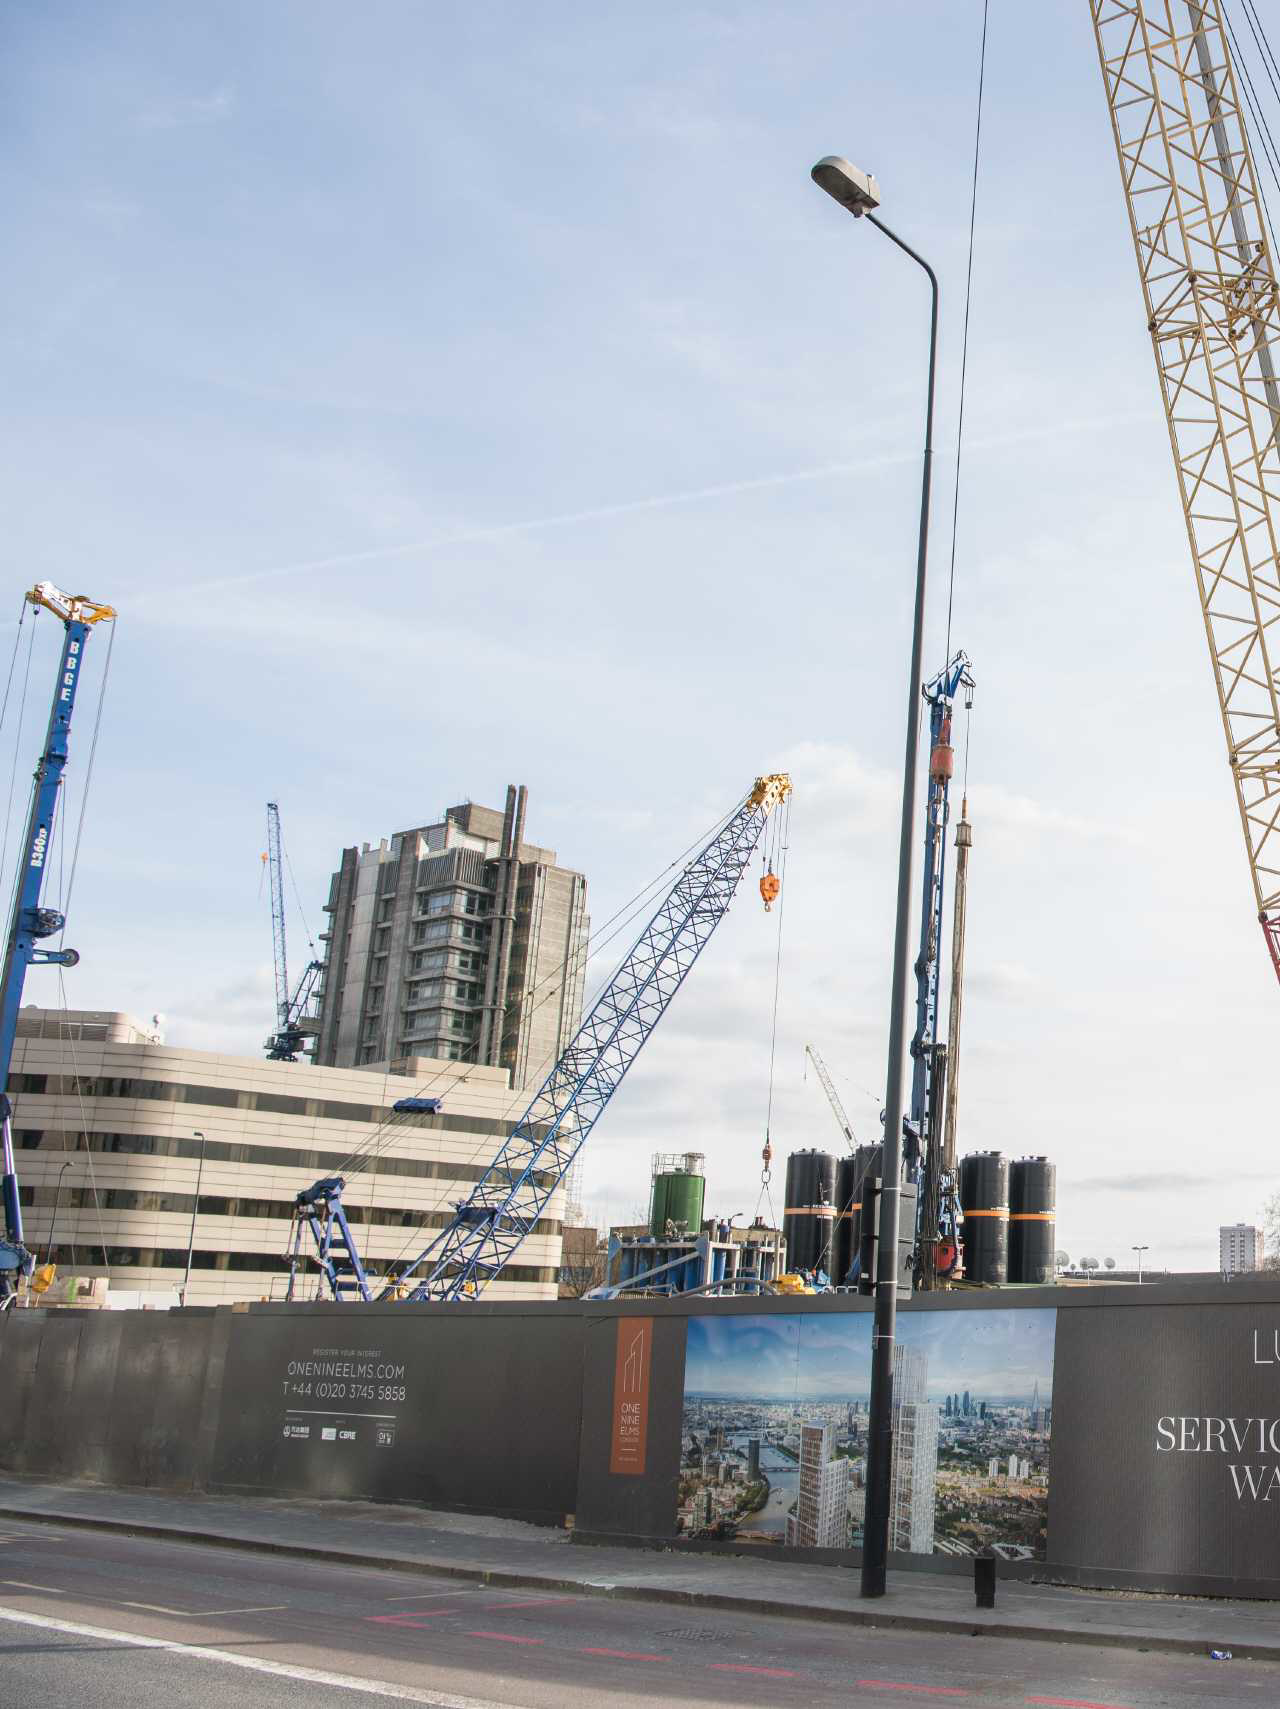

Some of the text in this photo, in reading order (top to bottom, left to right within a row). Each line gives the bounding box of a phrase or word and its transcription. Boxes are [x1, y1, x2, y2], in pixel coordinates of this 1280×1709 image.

[288, 1361, 405, 1379] ONENINEELMS.COM
[315, 1382, 346, 1398] (0)20
[349, 1384, 374, 1399] 3745
[378, 1385, 406, 1401] 5858
[621, 1403, 640, 1414] ONE
[621, 1415, 640, 1425] NINE
[620, 1426, 640, 1436] ELMS
